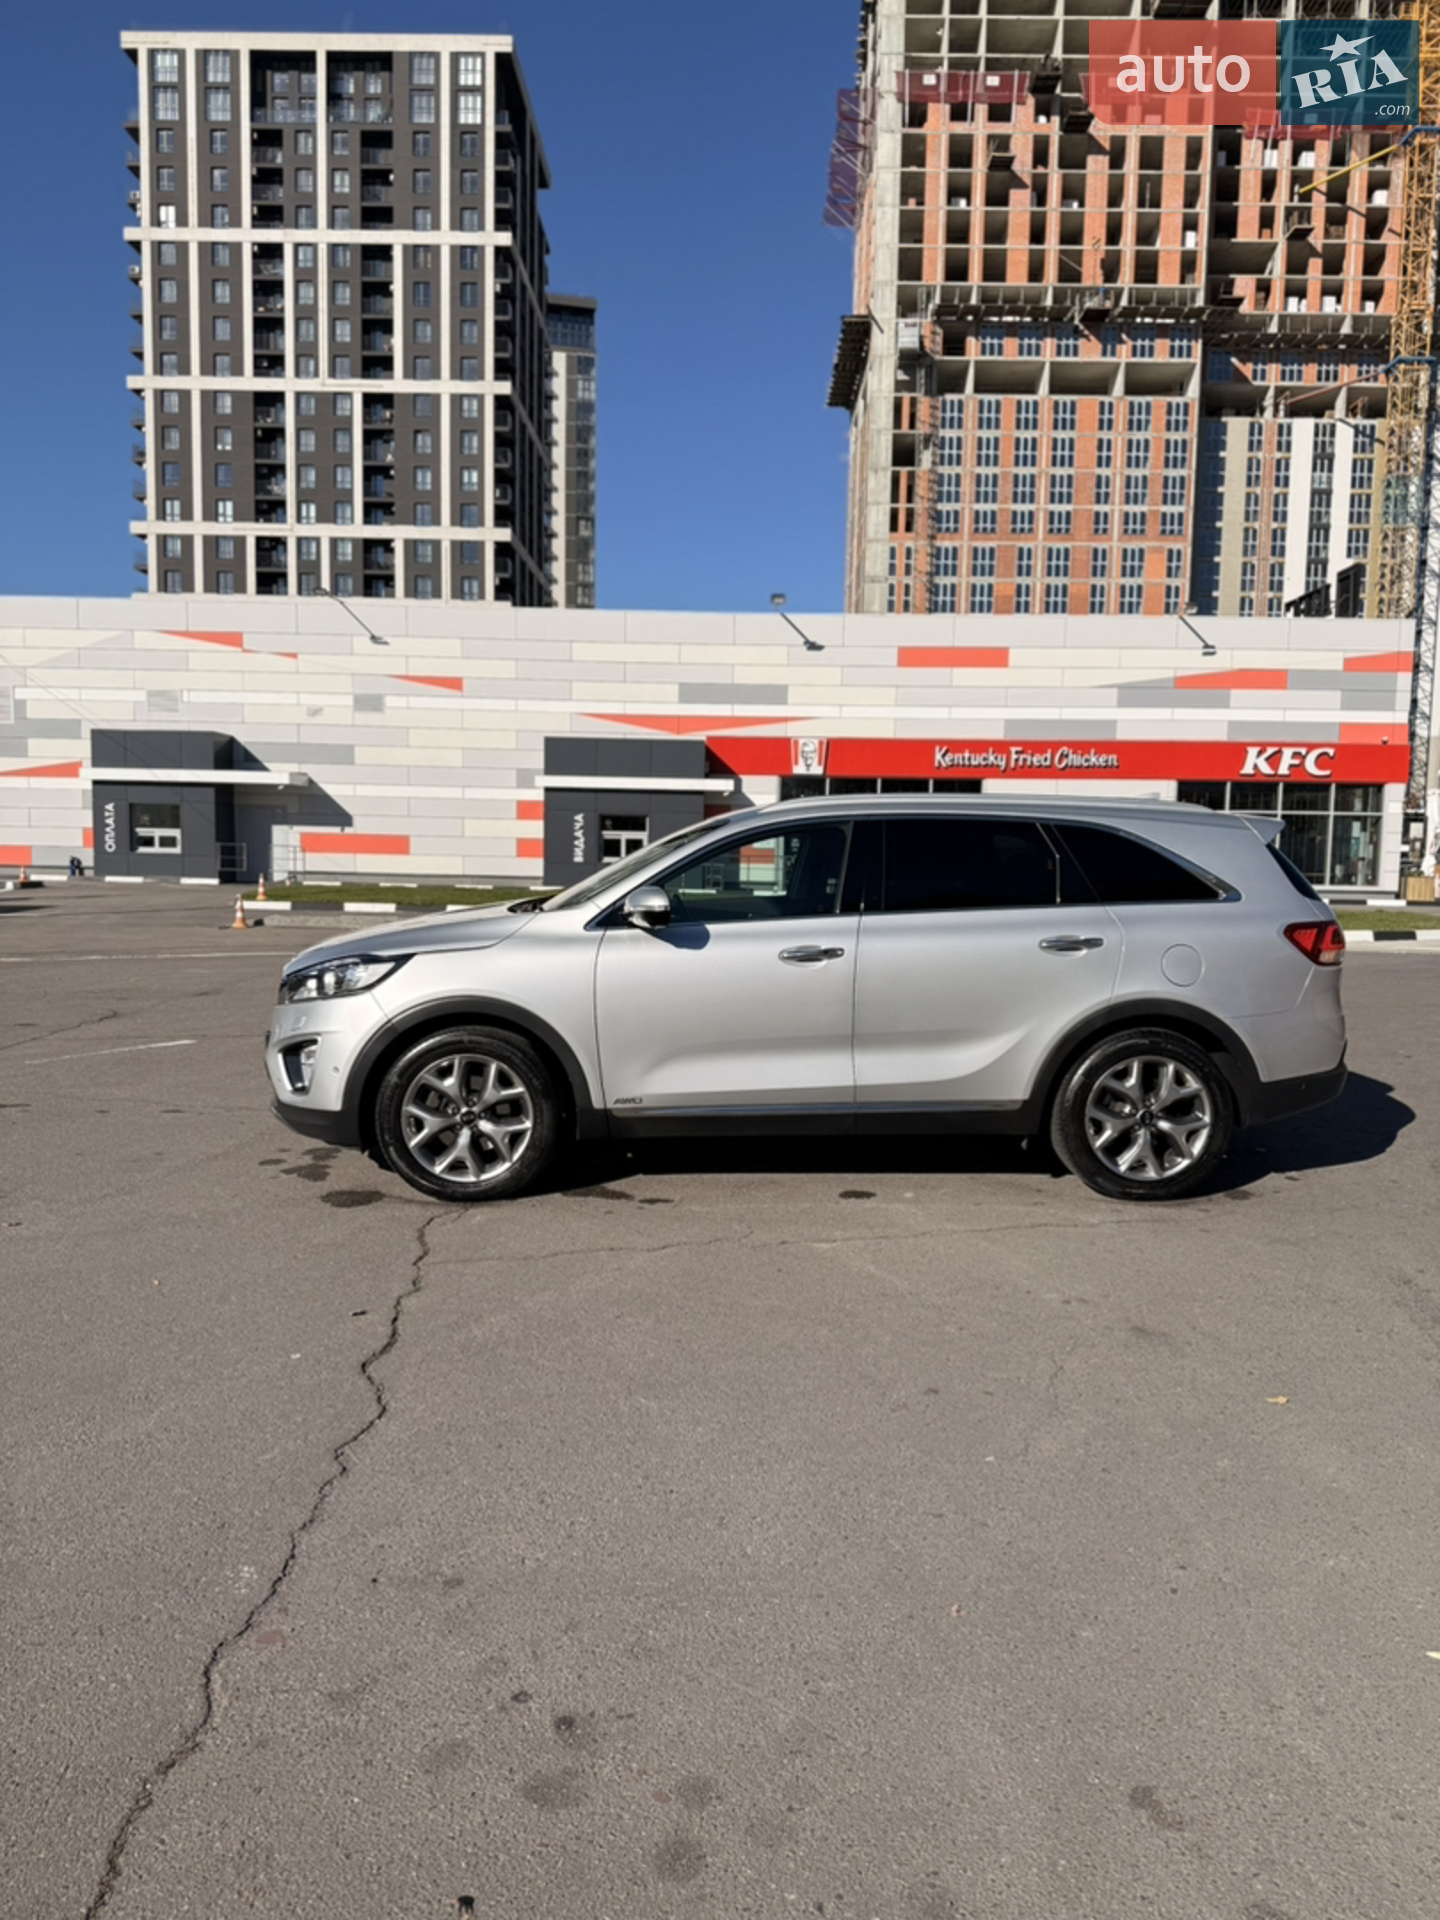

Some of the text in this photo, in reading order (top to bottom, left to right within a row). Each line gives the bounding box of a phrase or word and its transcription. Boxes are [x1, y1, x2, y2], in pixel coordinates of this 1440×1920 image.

[934, 745, 1119, 772] Kentucky Fried Chicken
[1239, 745, 1336, 777] KFC
[104, 801, 116, 853] ОПЛАТА
[573, 812, 585, 863] ВИДАЧА
